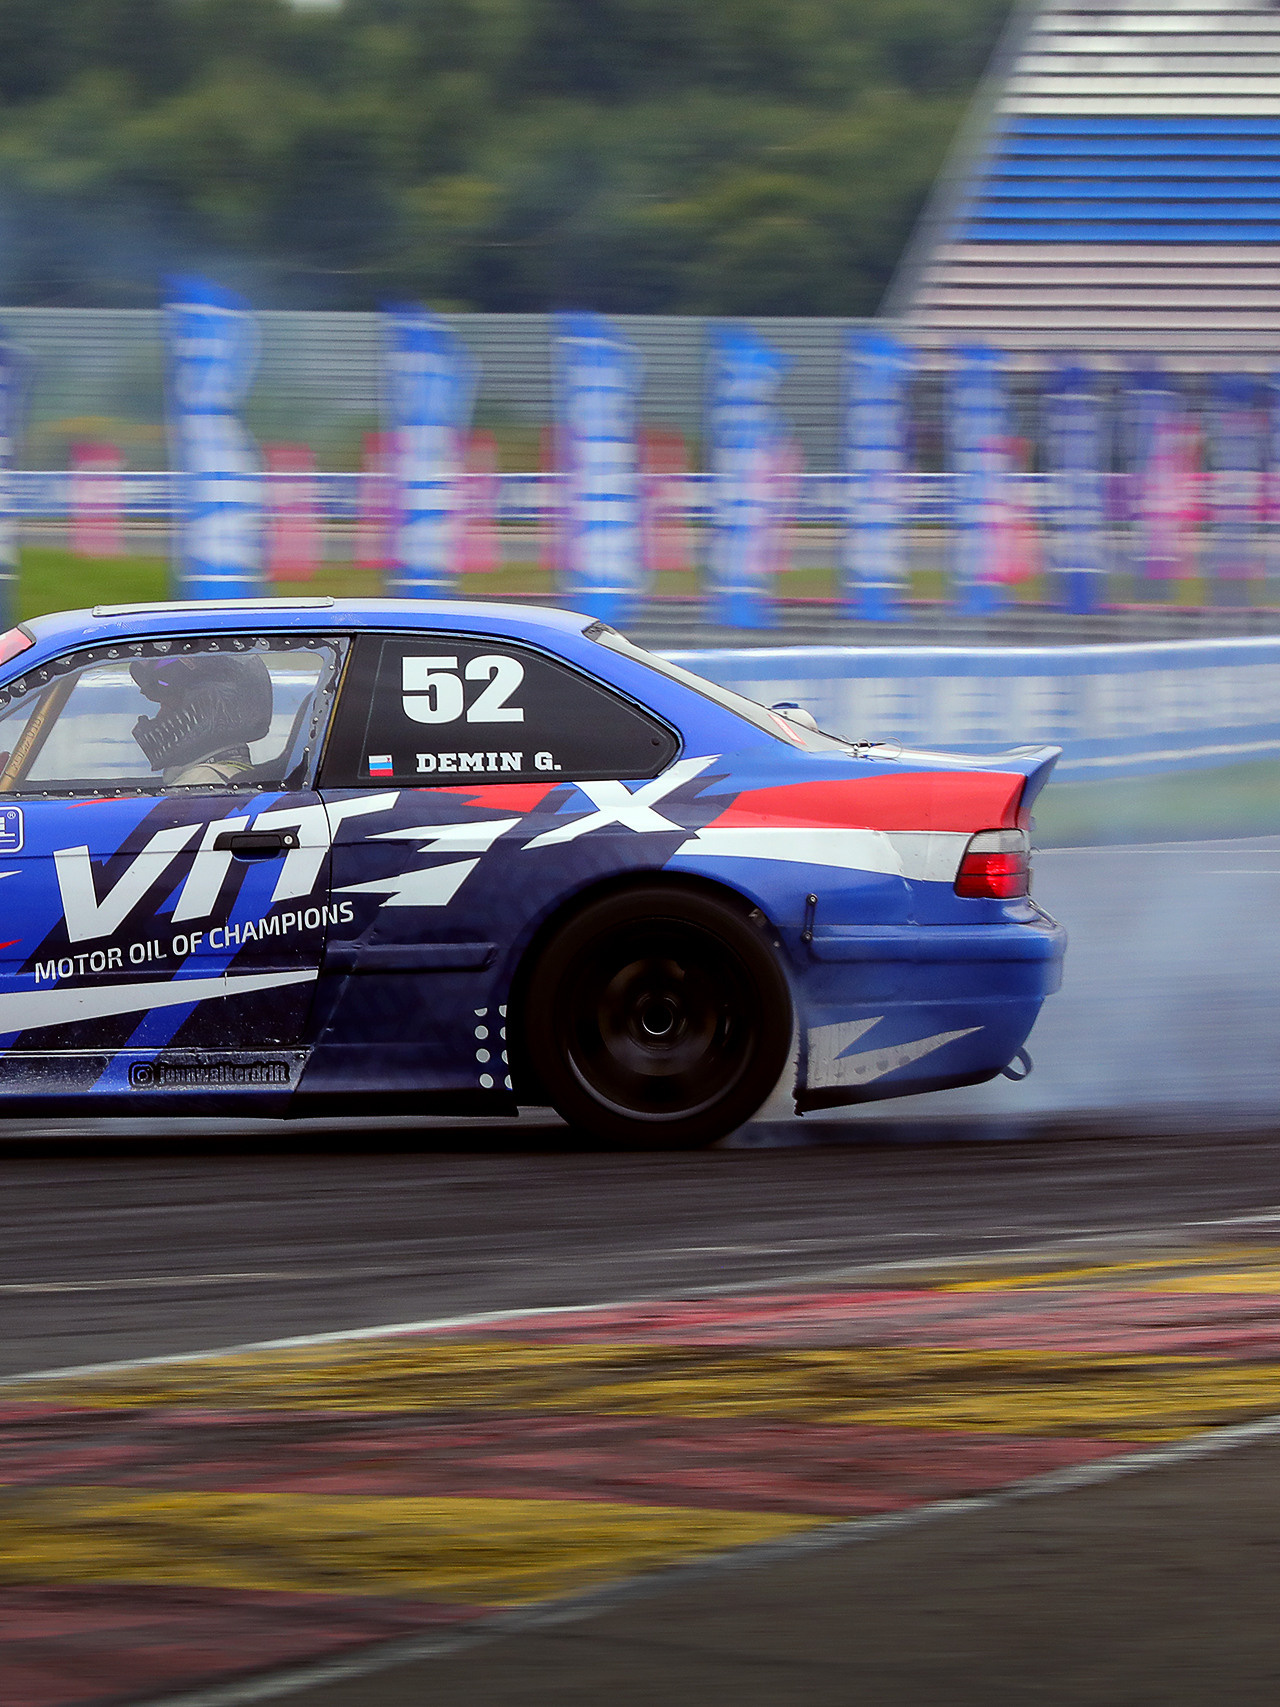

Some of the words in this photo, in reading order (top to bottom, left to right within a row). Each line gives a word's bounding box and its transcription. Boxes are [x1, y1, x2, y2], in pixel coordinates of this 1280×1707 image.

[402, 655, 524, 723] 52
[416, 752, 523, 773] DEMIN
[534, 751, 562, 771] G.
[54, 755, 721, 943] VITEX
[34, 948, 123, 983] MOTOR
[129, 939, 167, 965] OIL
[172, 931, 203, 956] OF
[209, 901, 355, 949] CHAMPIONS
